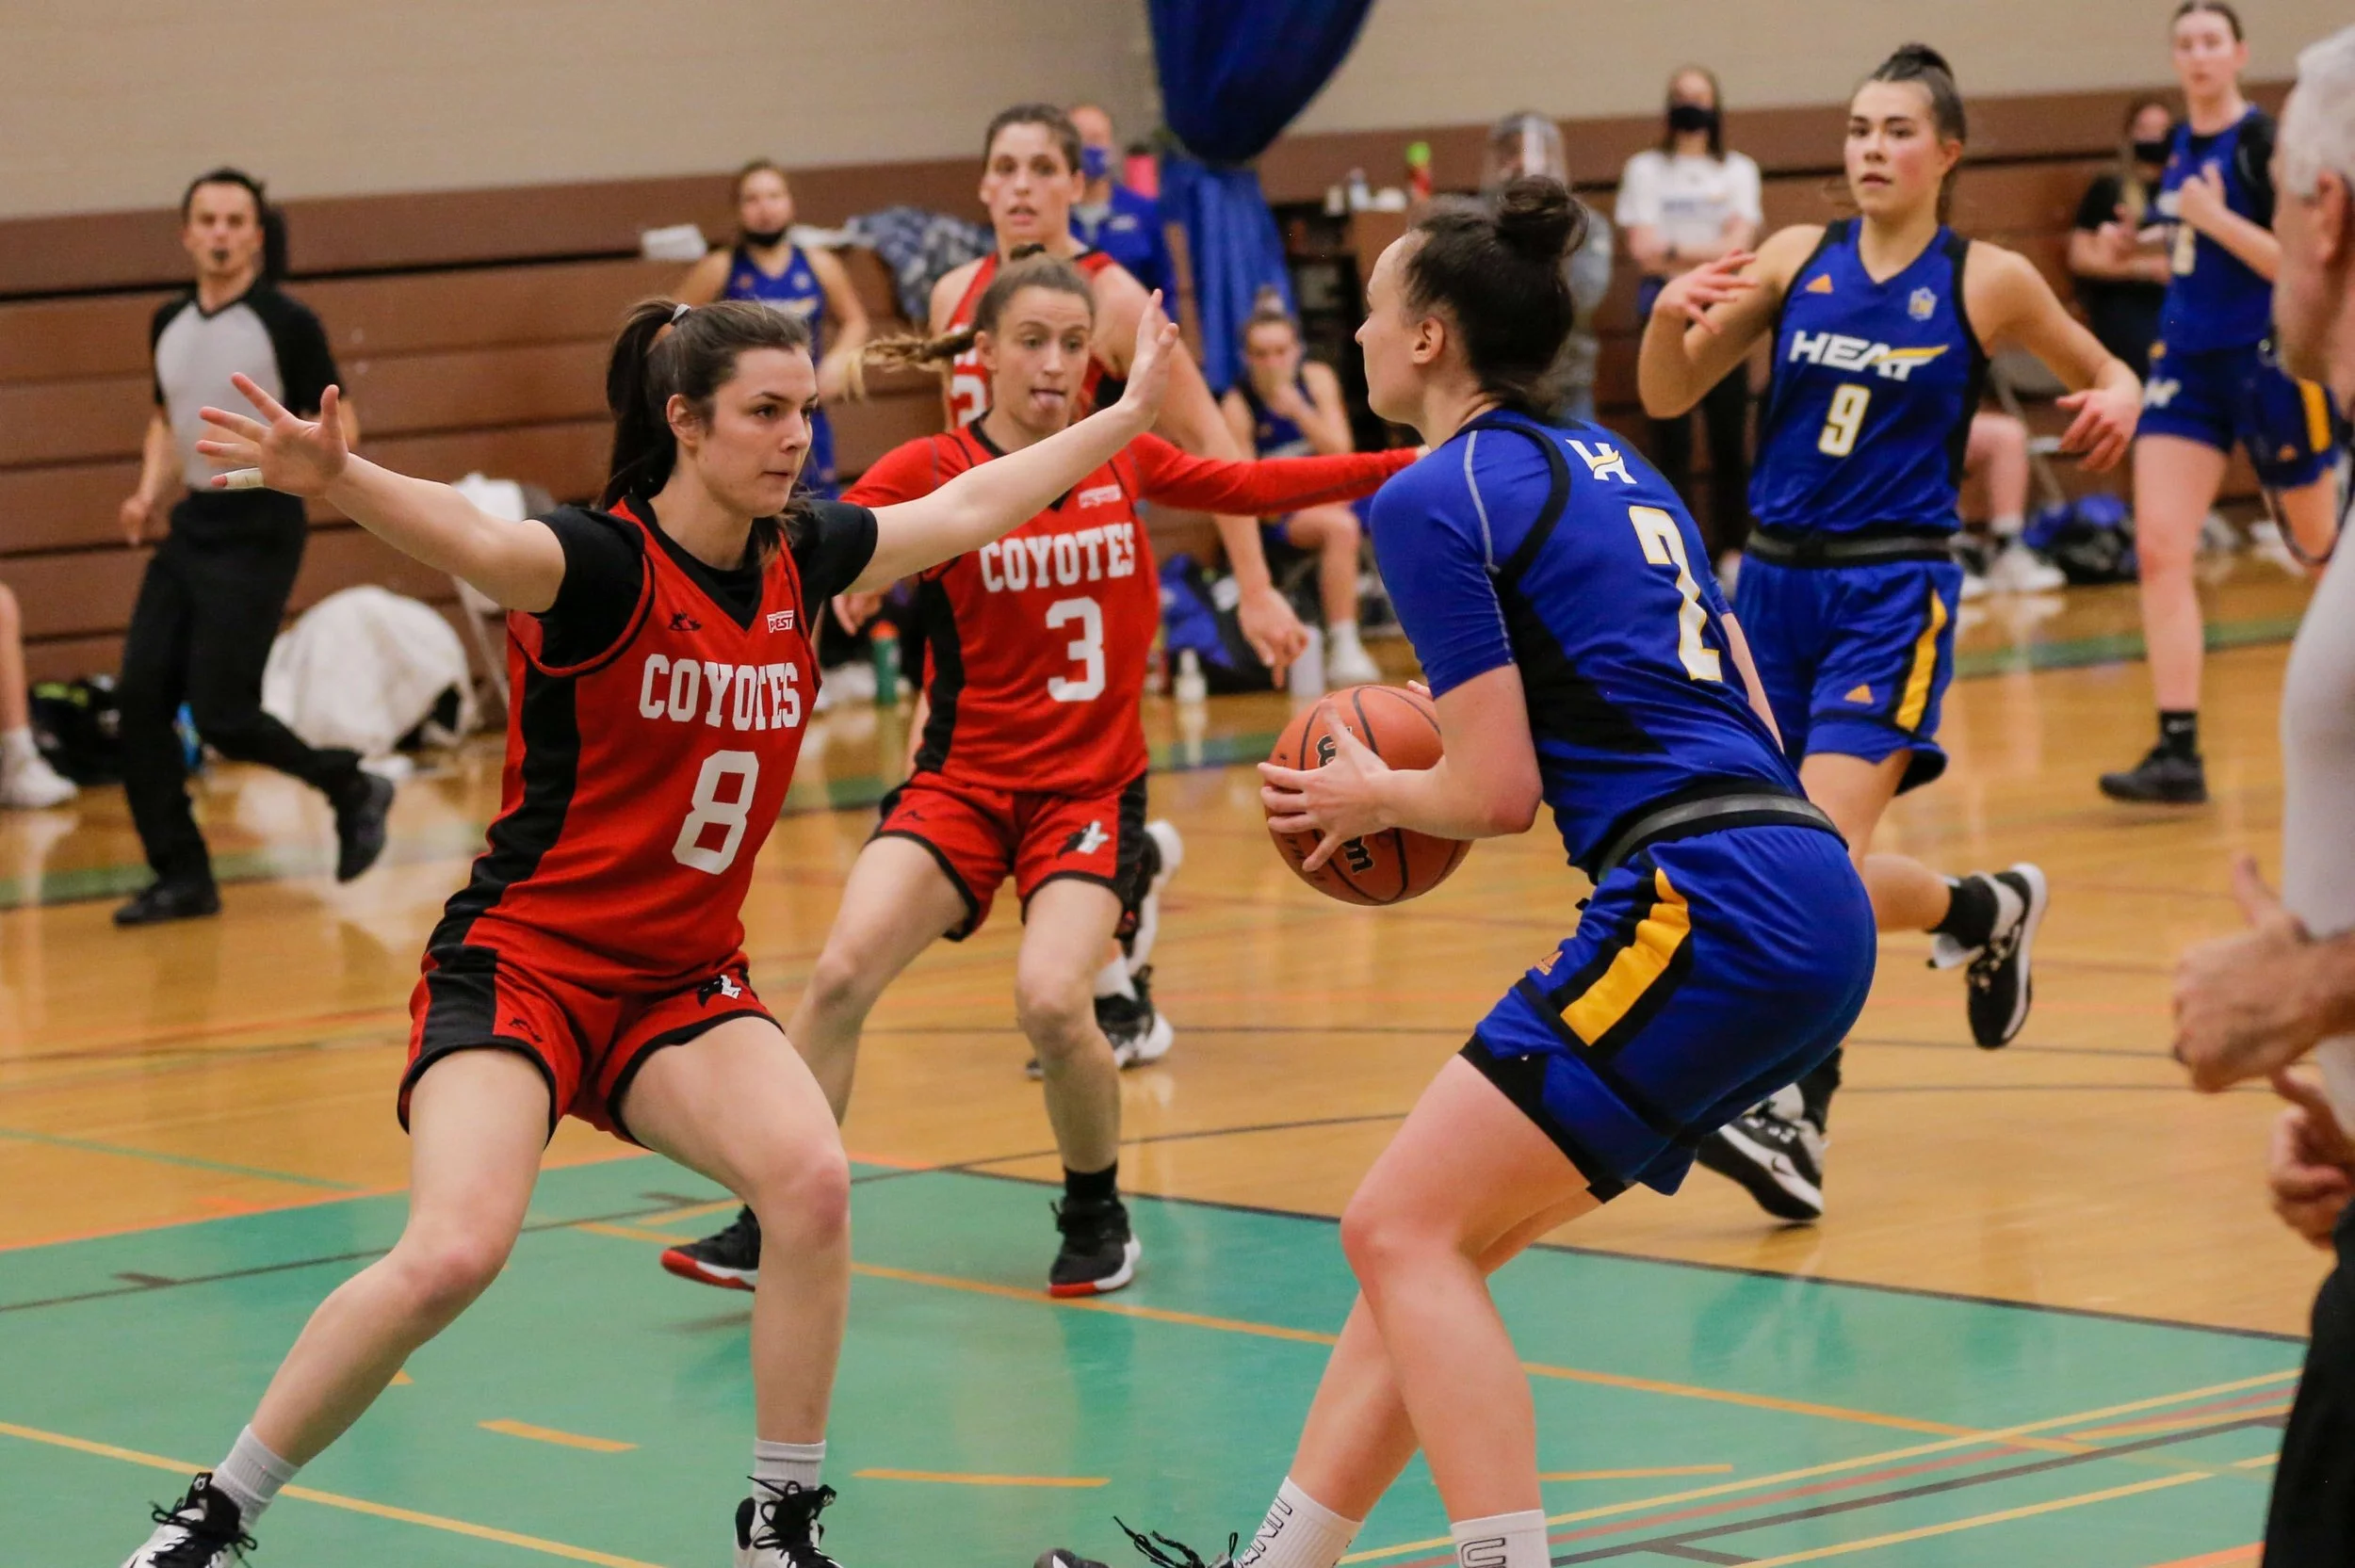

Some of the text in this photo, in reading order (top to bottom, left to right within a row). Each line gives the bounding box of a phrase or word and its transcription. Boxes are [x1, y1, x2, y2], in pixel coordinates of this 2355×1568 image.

[1789, 331, 1949, 382] HEAT
[1818, 382, 1872, 458] 9
[980, 522, 1135, 594] COYOTES
[1628, 505, 1723, 684] 2
[1045, 595, 1106, 703] 3
[639, 653, 801, 732] COYOTES
[672, 750, 760, 876] 8
